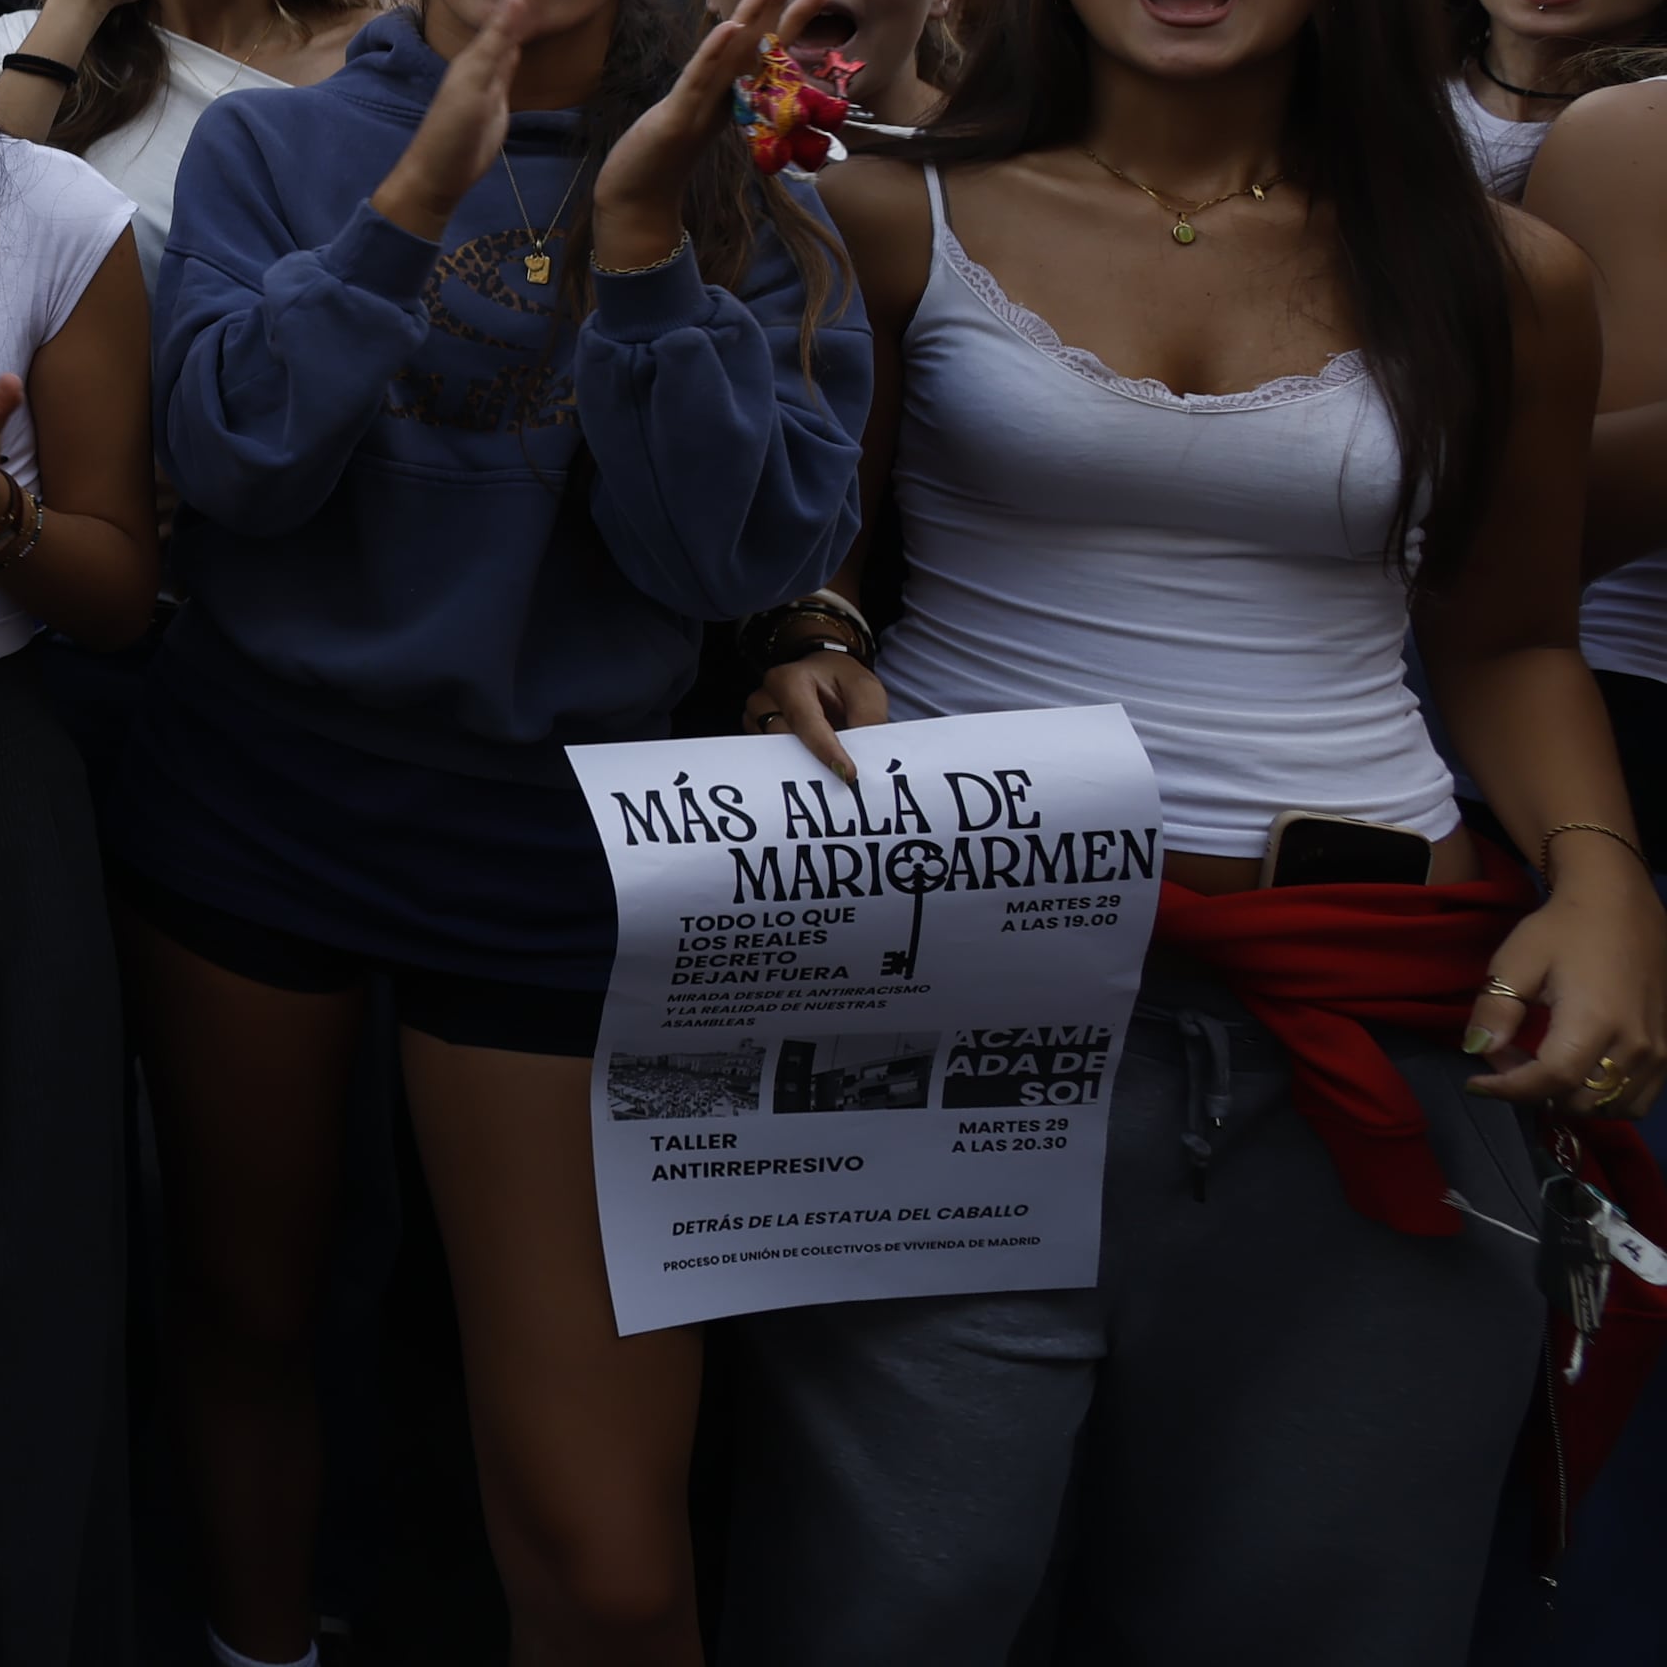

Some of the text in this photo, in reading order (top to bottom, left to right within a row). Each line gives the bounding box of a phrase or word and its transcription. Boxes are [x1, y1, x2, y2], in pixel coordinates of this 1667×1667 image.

[611, 758, 1041, 846] MÁS ALLÁ DE
[1006, 895, 1122, 914] MARTES 29
[680, 907, 856, 933] TODO LO QUE
[1001, 913, 1118, 932] A LAS 19.00
[678, 929, 828, 952] LOS REALES
[675, 950, 797, 969] DECRETO
[671, 966, 849, 986] DEJAN FUERA
[666, 984, 931, 1003] MIRADA DESDE EL ANTIRRACISMO
[666, 1000, 887, 1015] Y LA REALIDAD DE NUESTRAS
[661, 1017, 756, 1028] ASAMBLEAS
[944, 1051, 1109, 1077] ADA DE
[1019, 1080, 1099, 1106] SOL
[959, 1118, 1069, 1134] MARTES 29
[650, 1133, 738, 1152] TALLER
[952, 1136, 1067, 1153] A LAS 20.30
[652, 1155, 864, 1182] ANTIRREPRESIVO
[672, 1204, 1029, 1236] DETRÁS DE LA ESTATUA DEL CABALLO
[663, 1236, 1041, 1273] PROCESO DE UNIÓN DE COLECTIVOS DE VIVIENDA DE MADRID
